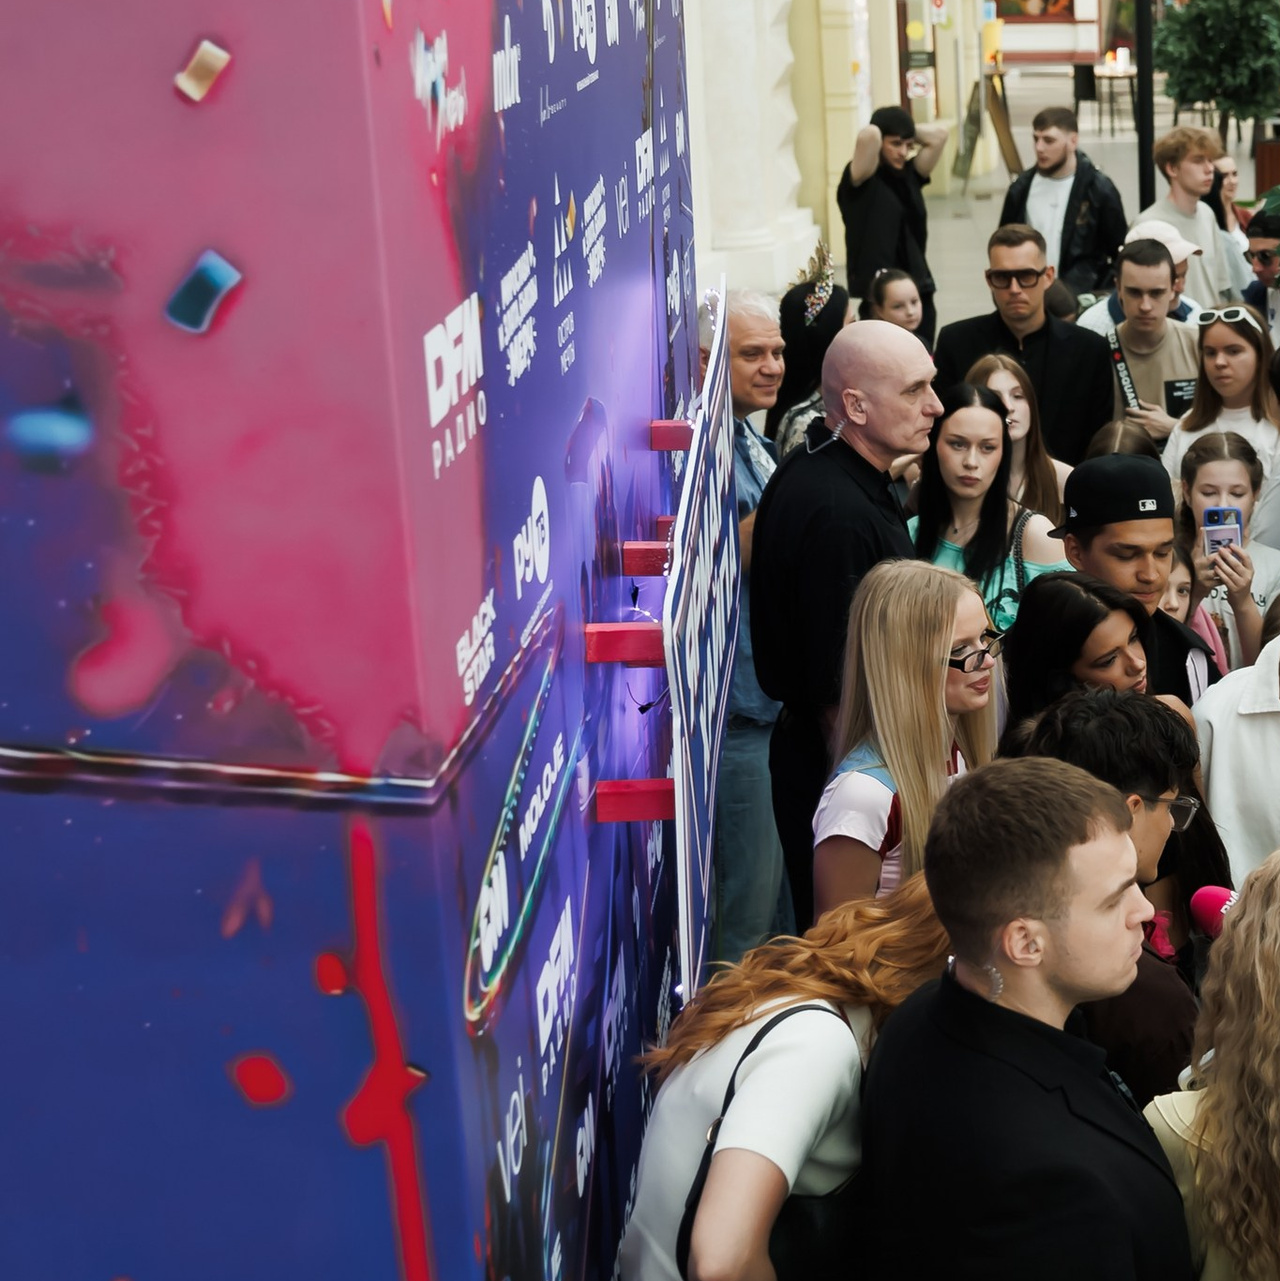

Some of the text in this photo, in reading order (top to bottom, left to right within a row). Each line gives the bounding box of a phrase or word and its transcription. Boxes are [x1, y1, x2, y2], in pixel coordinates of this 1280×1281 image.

[423, 291, 484, 429] DFM
[432, 389, 487, 480] РАДИО
[685, 370, 734, 733] ЯРМАРКА
[455, 587, 497, 679] BLACK
[463, 640, 497, 707] STAR
[699, 507, 736, 804] ХАЙПА
[519, 732, 564, 861] MOLOJE
[536, 894, 576, 1057] DFM
[542, 971, 579, 1096] РАДИО
[497, 1055, 528, 1203] vei
